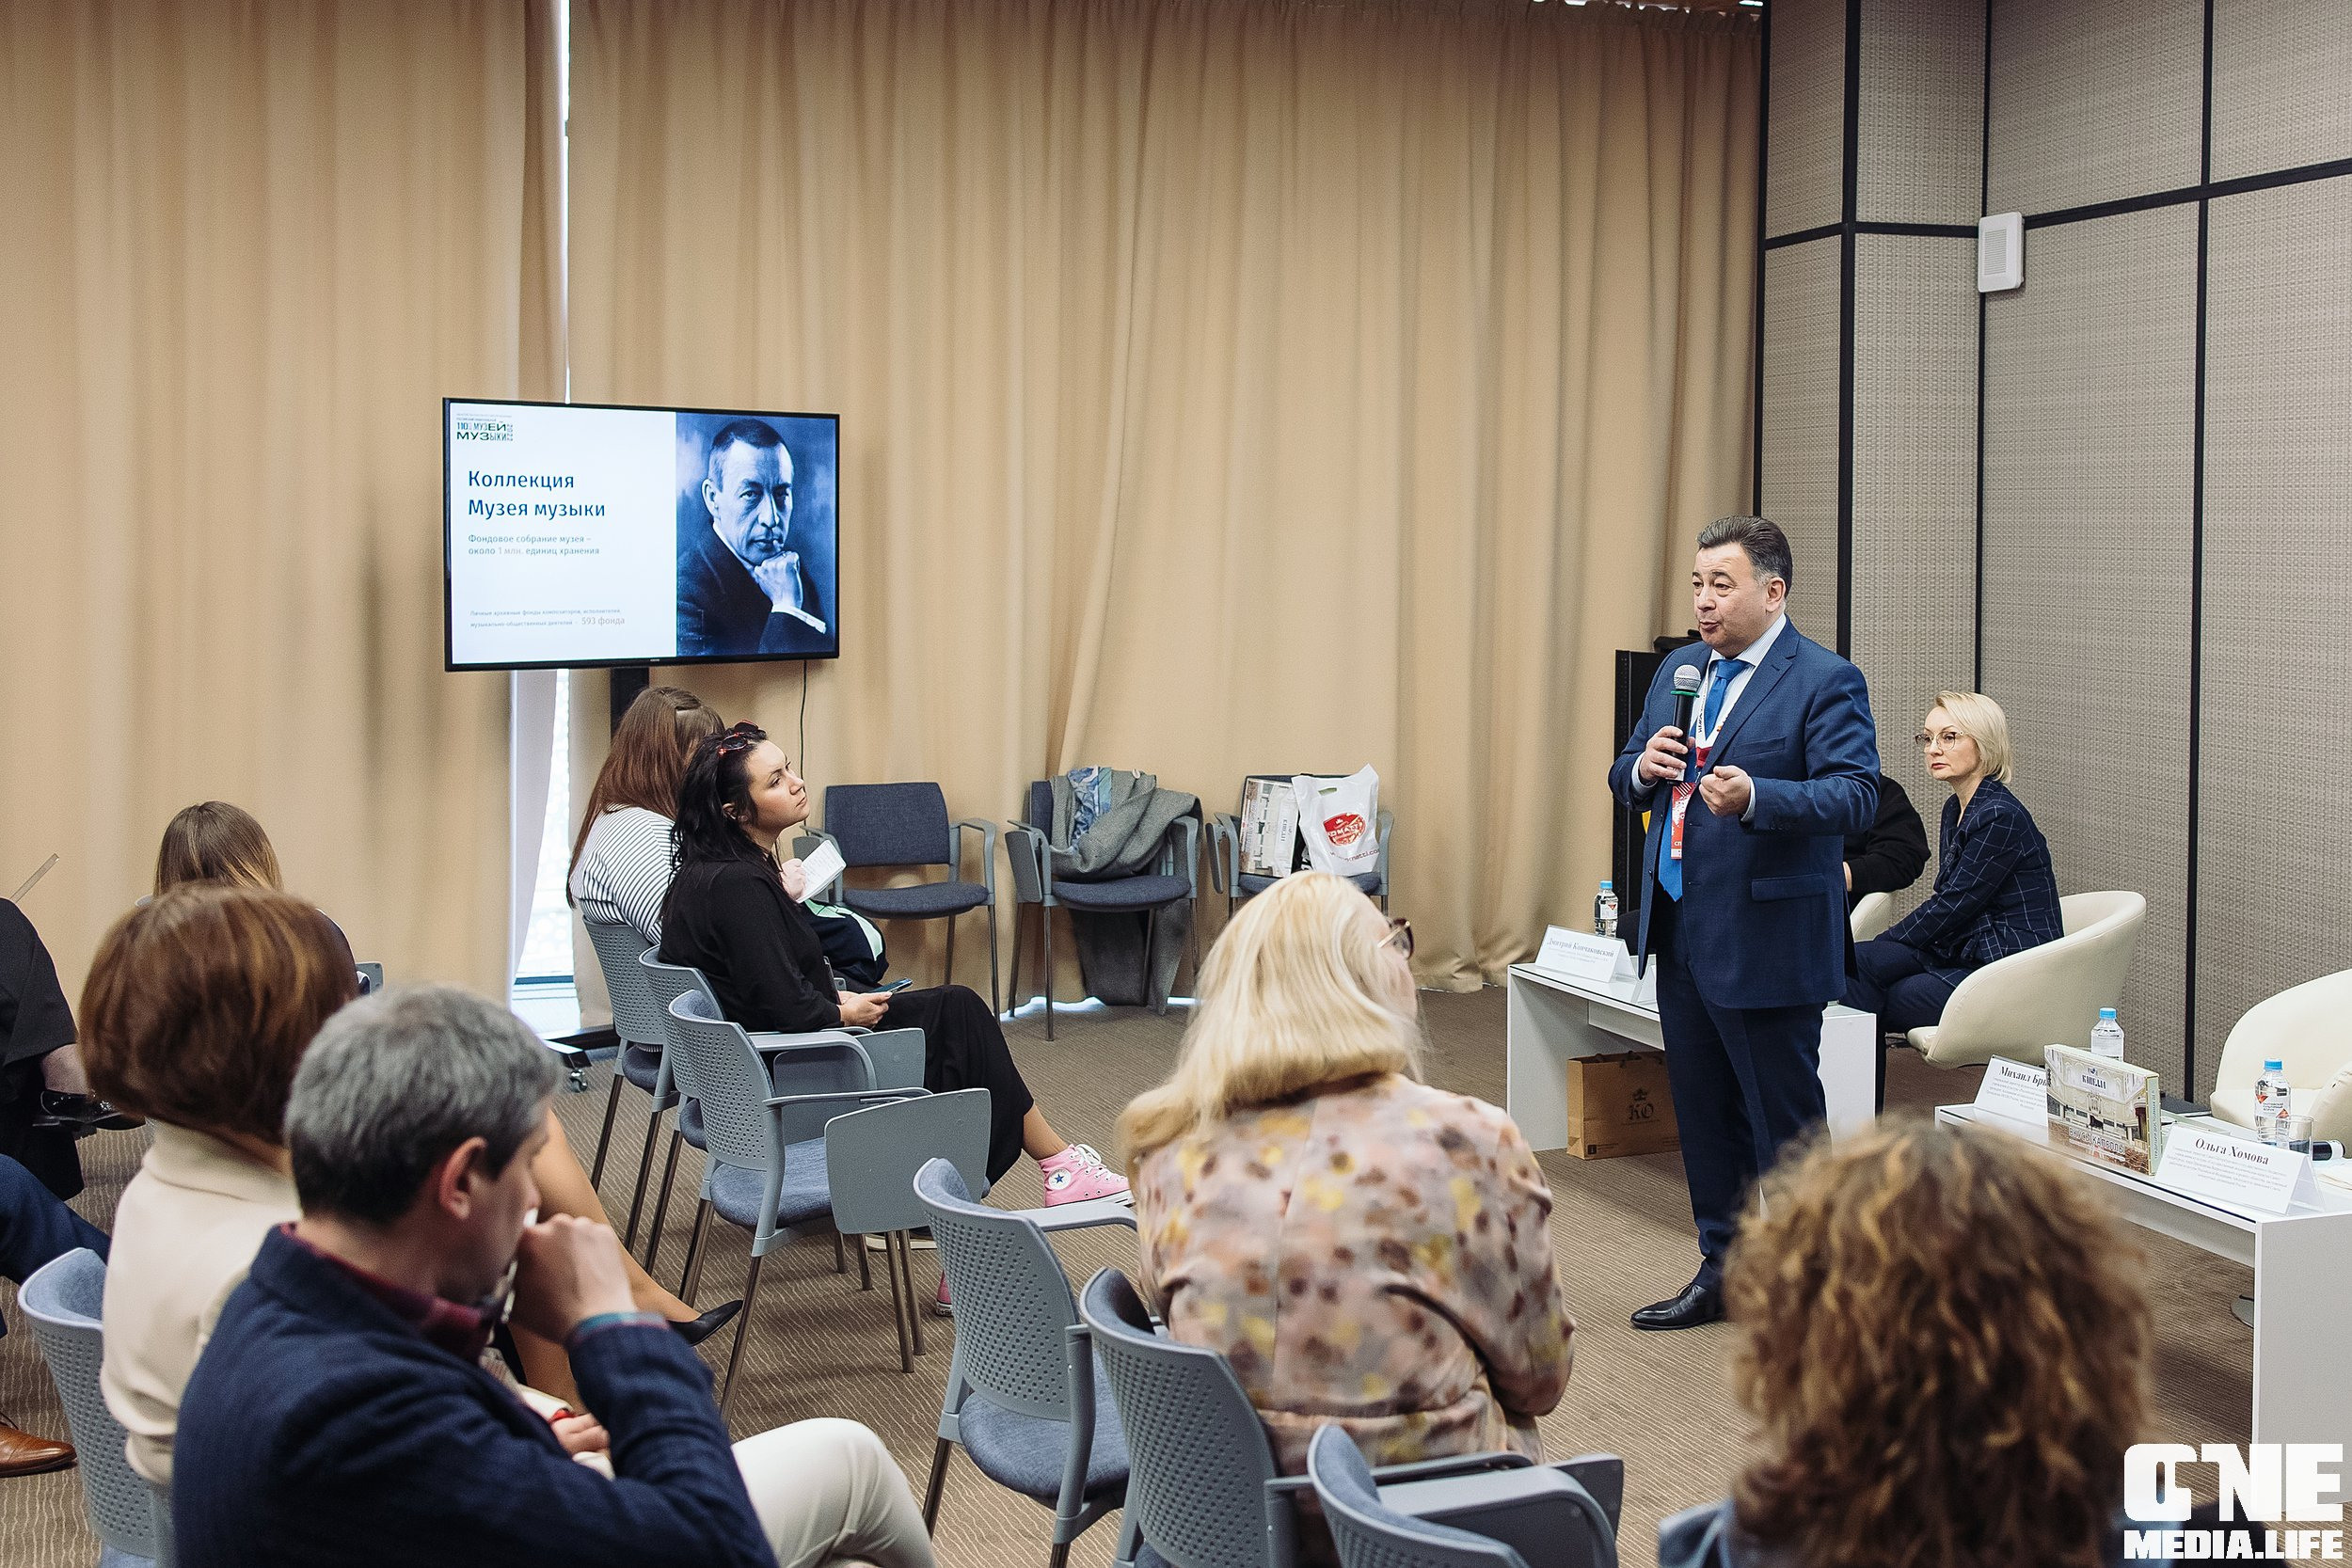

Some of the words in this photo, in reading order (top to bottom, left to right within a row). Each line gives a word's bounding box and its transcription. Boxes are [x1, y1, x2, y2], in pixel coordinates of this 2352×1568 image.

[456, 431, 506, 441] МУЗЫКИ
[469, 470, 575, 492] Коллекция
[468, 499, 528, 520] Музея
[534, 503, 605, 520] музыки
[468, 534, 514, 544] Фондовое
[516, 535, 558, 544] собрание
[559, 536, 584, 545] музея
[525, 548, 558, 557] единиц
[580, 616, 596, 625] 593
[597, 616, 626, 626] фонда
[1999, 1066, 2031, 1083] Михаил
[2195, 1137, 2227, 1155] Ольга
[2229, 1146, 2269, 1165] Хомова
